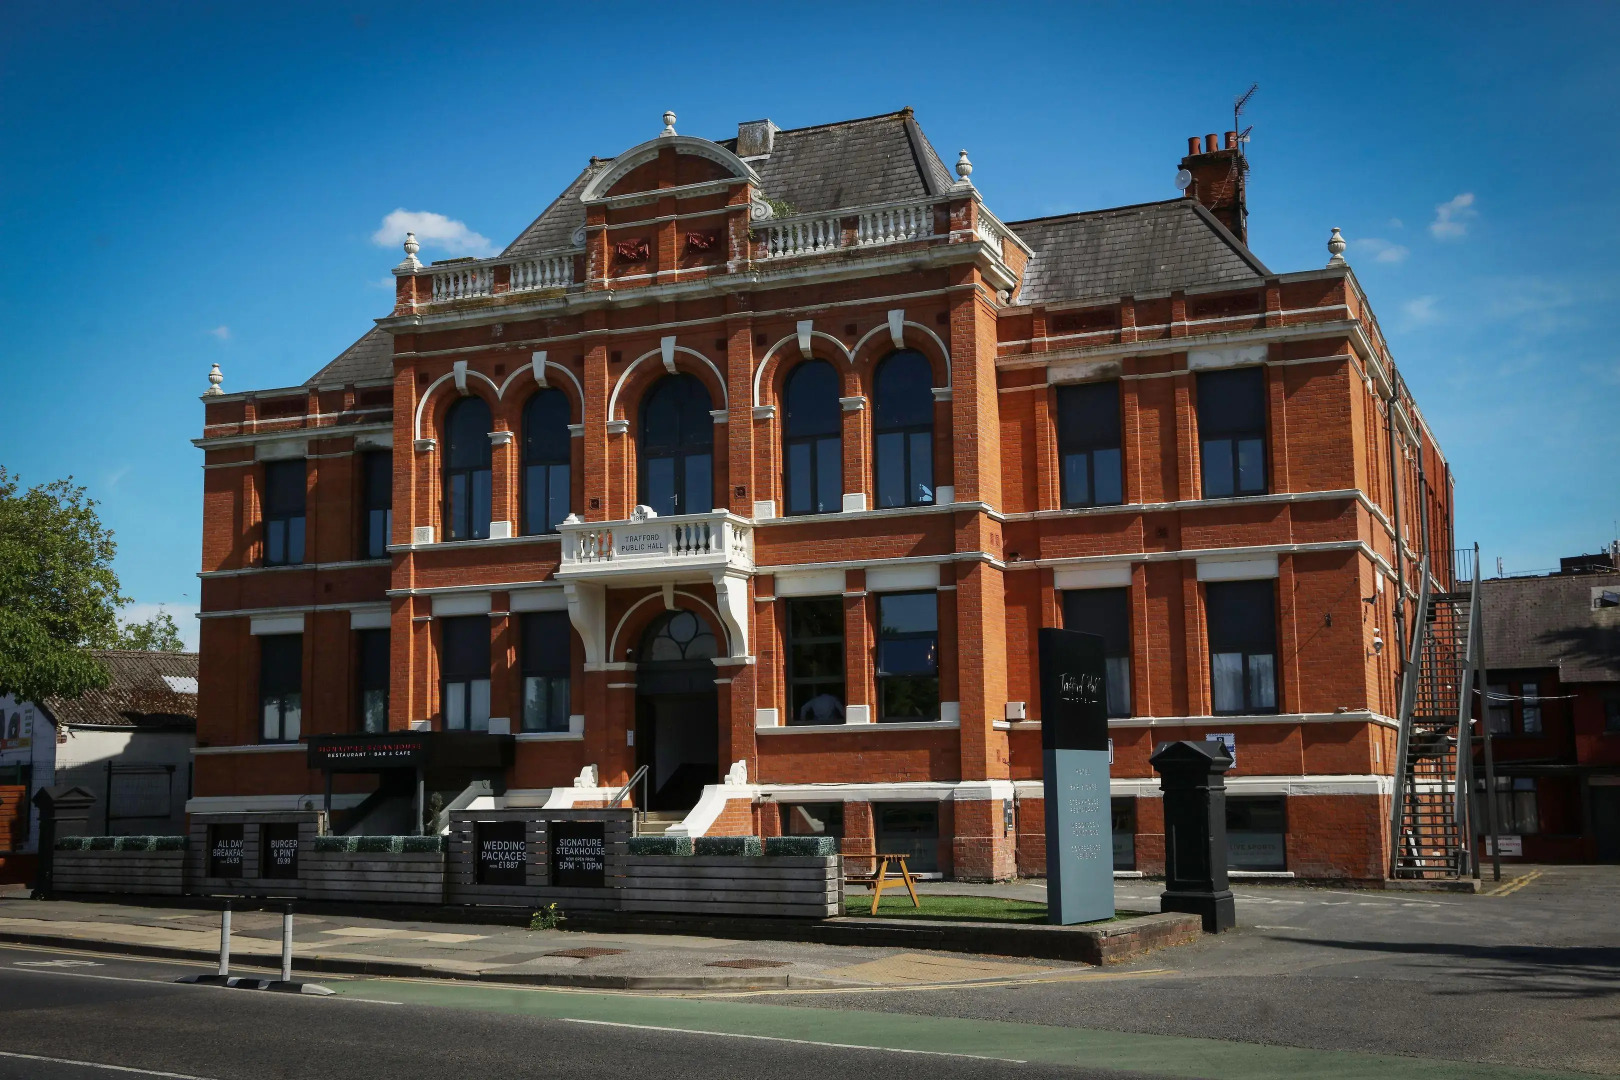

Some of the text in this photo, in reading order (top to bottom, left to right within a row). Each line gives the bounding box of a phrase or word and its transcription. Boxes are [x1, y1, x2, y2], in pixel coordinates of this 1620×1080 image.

[625, 533, 660, 543] TRAFFORD
[621, 542, 664, 552] PUBLIC HALL
[217, 839, 244, 848] ALL DAY
[270, 839, 298, 848] BURGER
[483, 840, 526, 851] WEDDING
[559, 838, 602, 847] SIGNATURE
[212, 848, 244, 857] BREAKFAS
[273, 848, 295, 858] & PINT
[481, 851, 527, 861] PACKAGES
[556, 847, 605, 856] STEAKHOUSE
[498, 861, 519, 869] £1887
[559, 862, 575, 870] 5PM
[582, 862, 603, 870] 10PM
